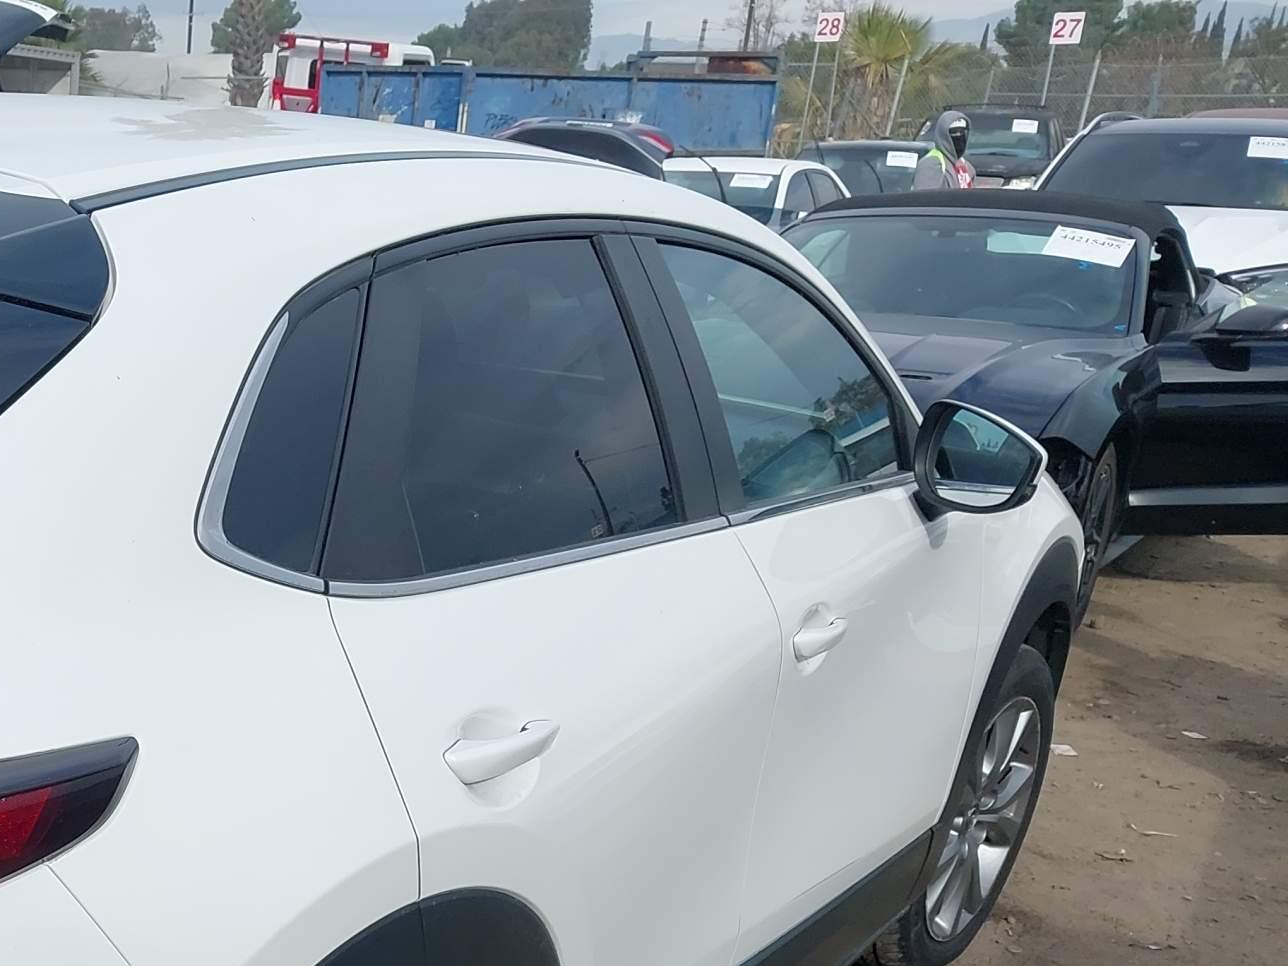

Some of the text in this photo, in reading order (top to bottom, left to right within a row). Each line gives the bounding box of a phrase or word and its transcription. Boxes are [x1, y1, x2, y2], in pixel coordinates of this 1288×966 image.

[817, 18, 841, 36] 28
[1053, 18, 1082, 38] 27
[1059, 233, 1122, 250] 44215495
